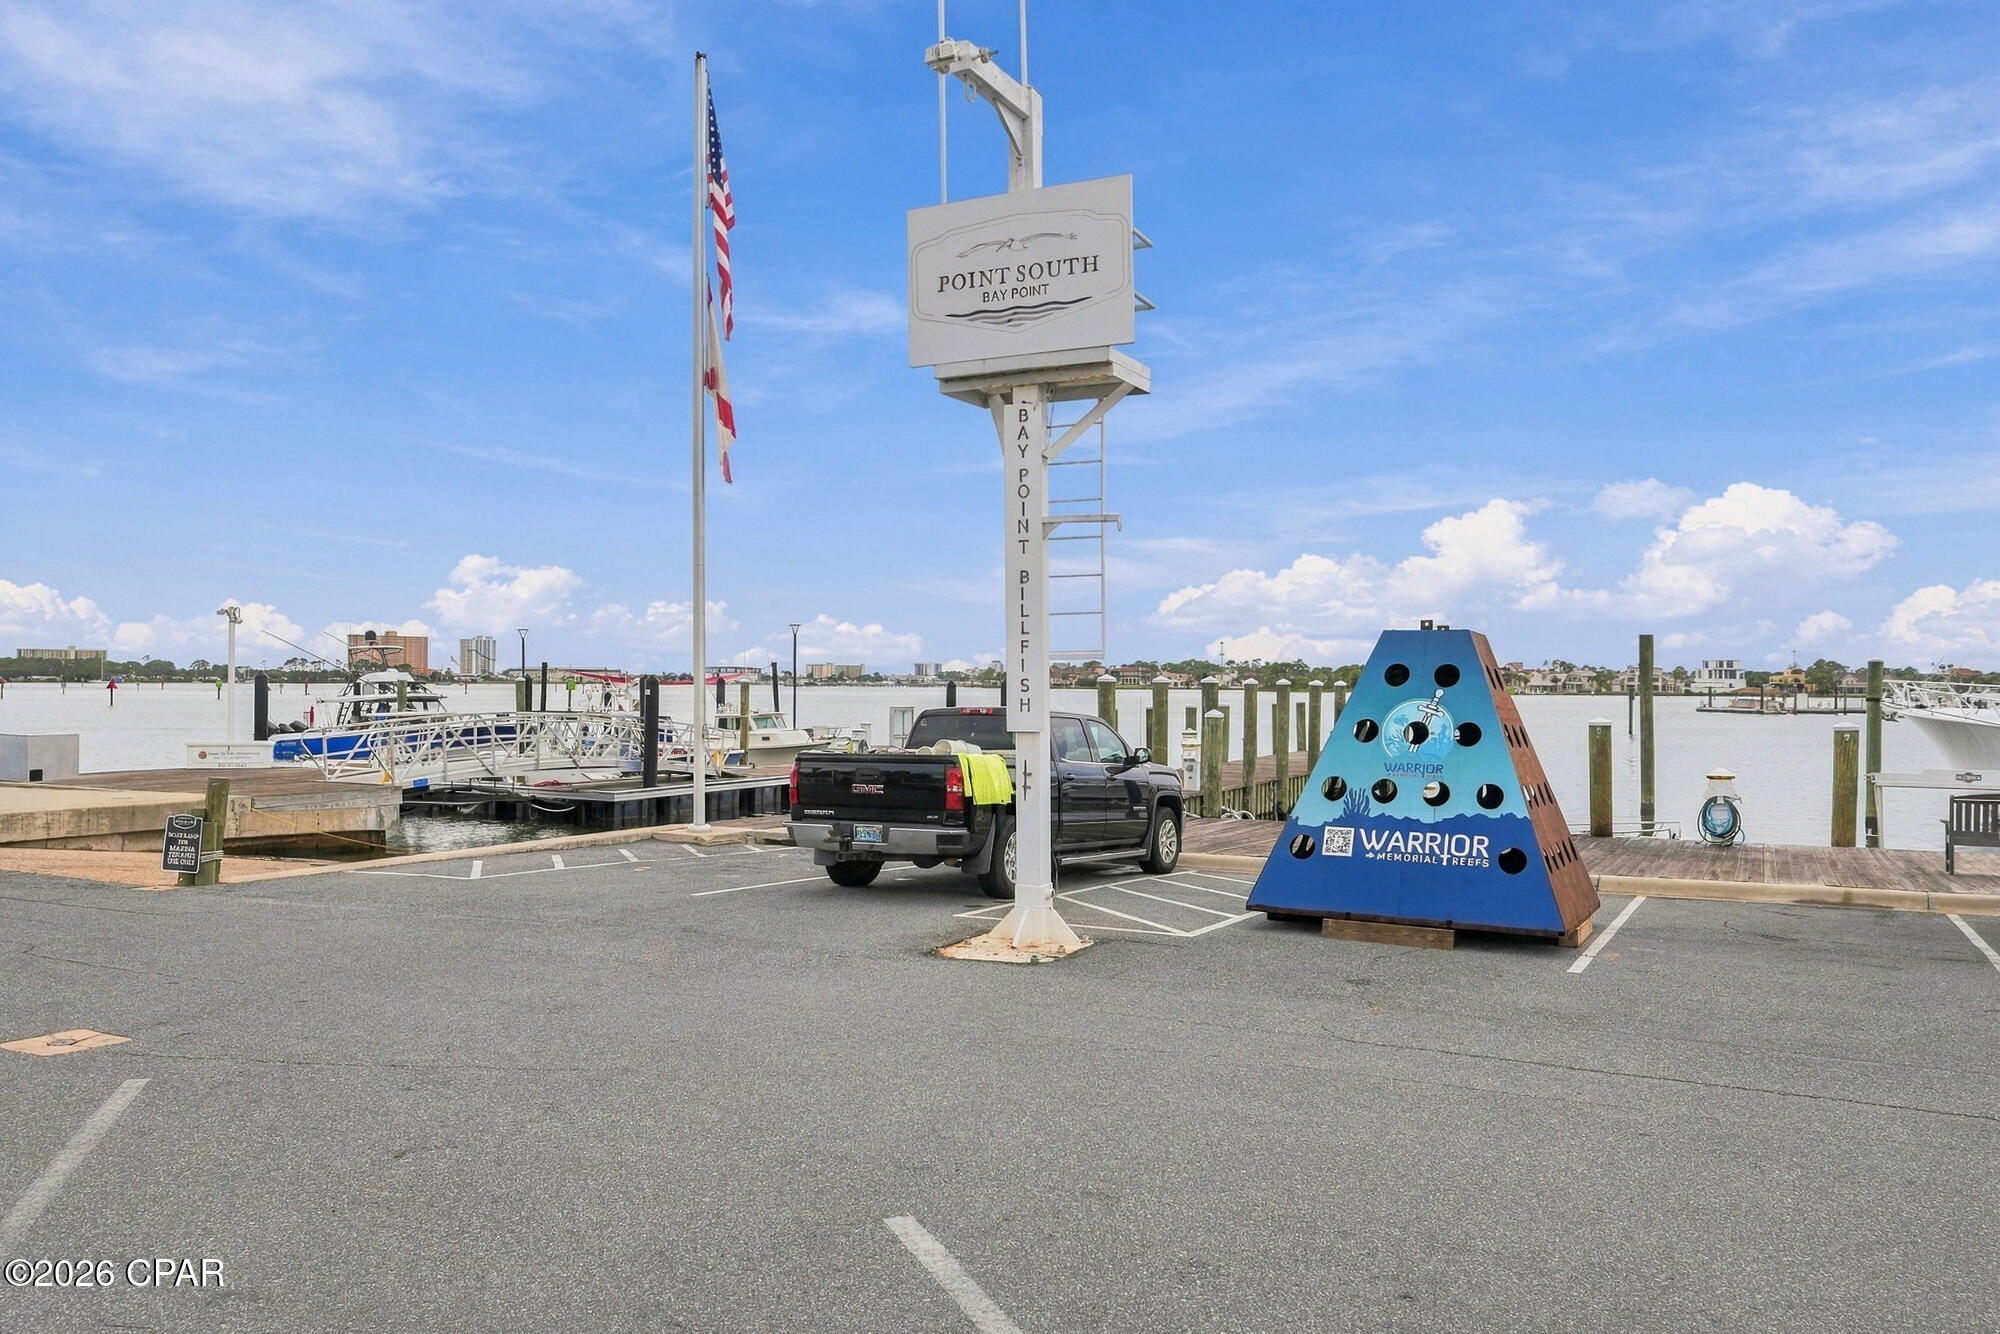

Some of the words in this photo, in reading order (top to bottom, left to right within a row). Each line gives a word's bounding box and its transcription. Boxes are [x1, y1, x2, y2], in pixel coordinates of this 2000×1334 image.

[937, 267, 1010, 293] POINT
[1016, 254, 1099, 282] SOUTH
[982, 289, 1007, 303] BAY
[1011, 283, 1050, 299] POINT
[1017, 408, 1029, 458] BAY
[1017, 468, 1030, 554] POINT
[1019, 570, 1031, 713] BILLFISH
[1384, 762, 1444, 777] WARRIOR
[852, 784, 884, 794] GMC
[1359, 828, 1489, 862] WARRIOR
[1377, 853, 1438, 864] MEMORIAL
[1452, 857, 1490, 868] REEFS
